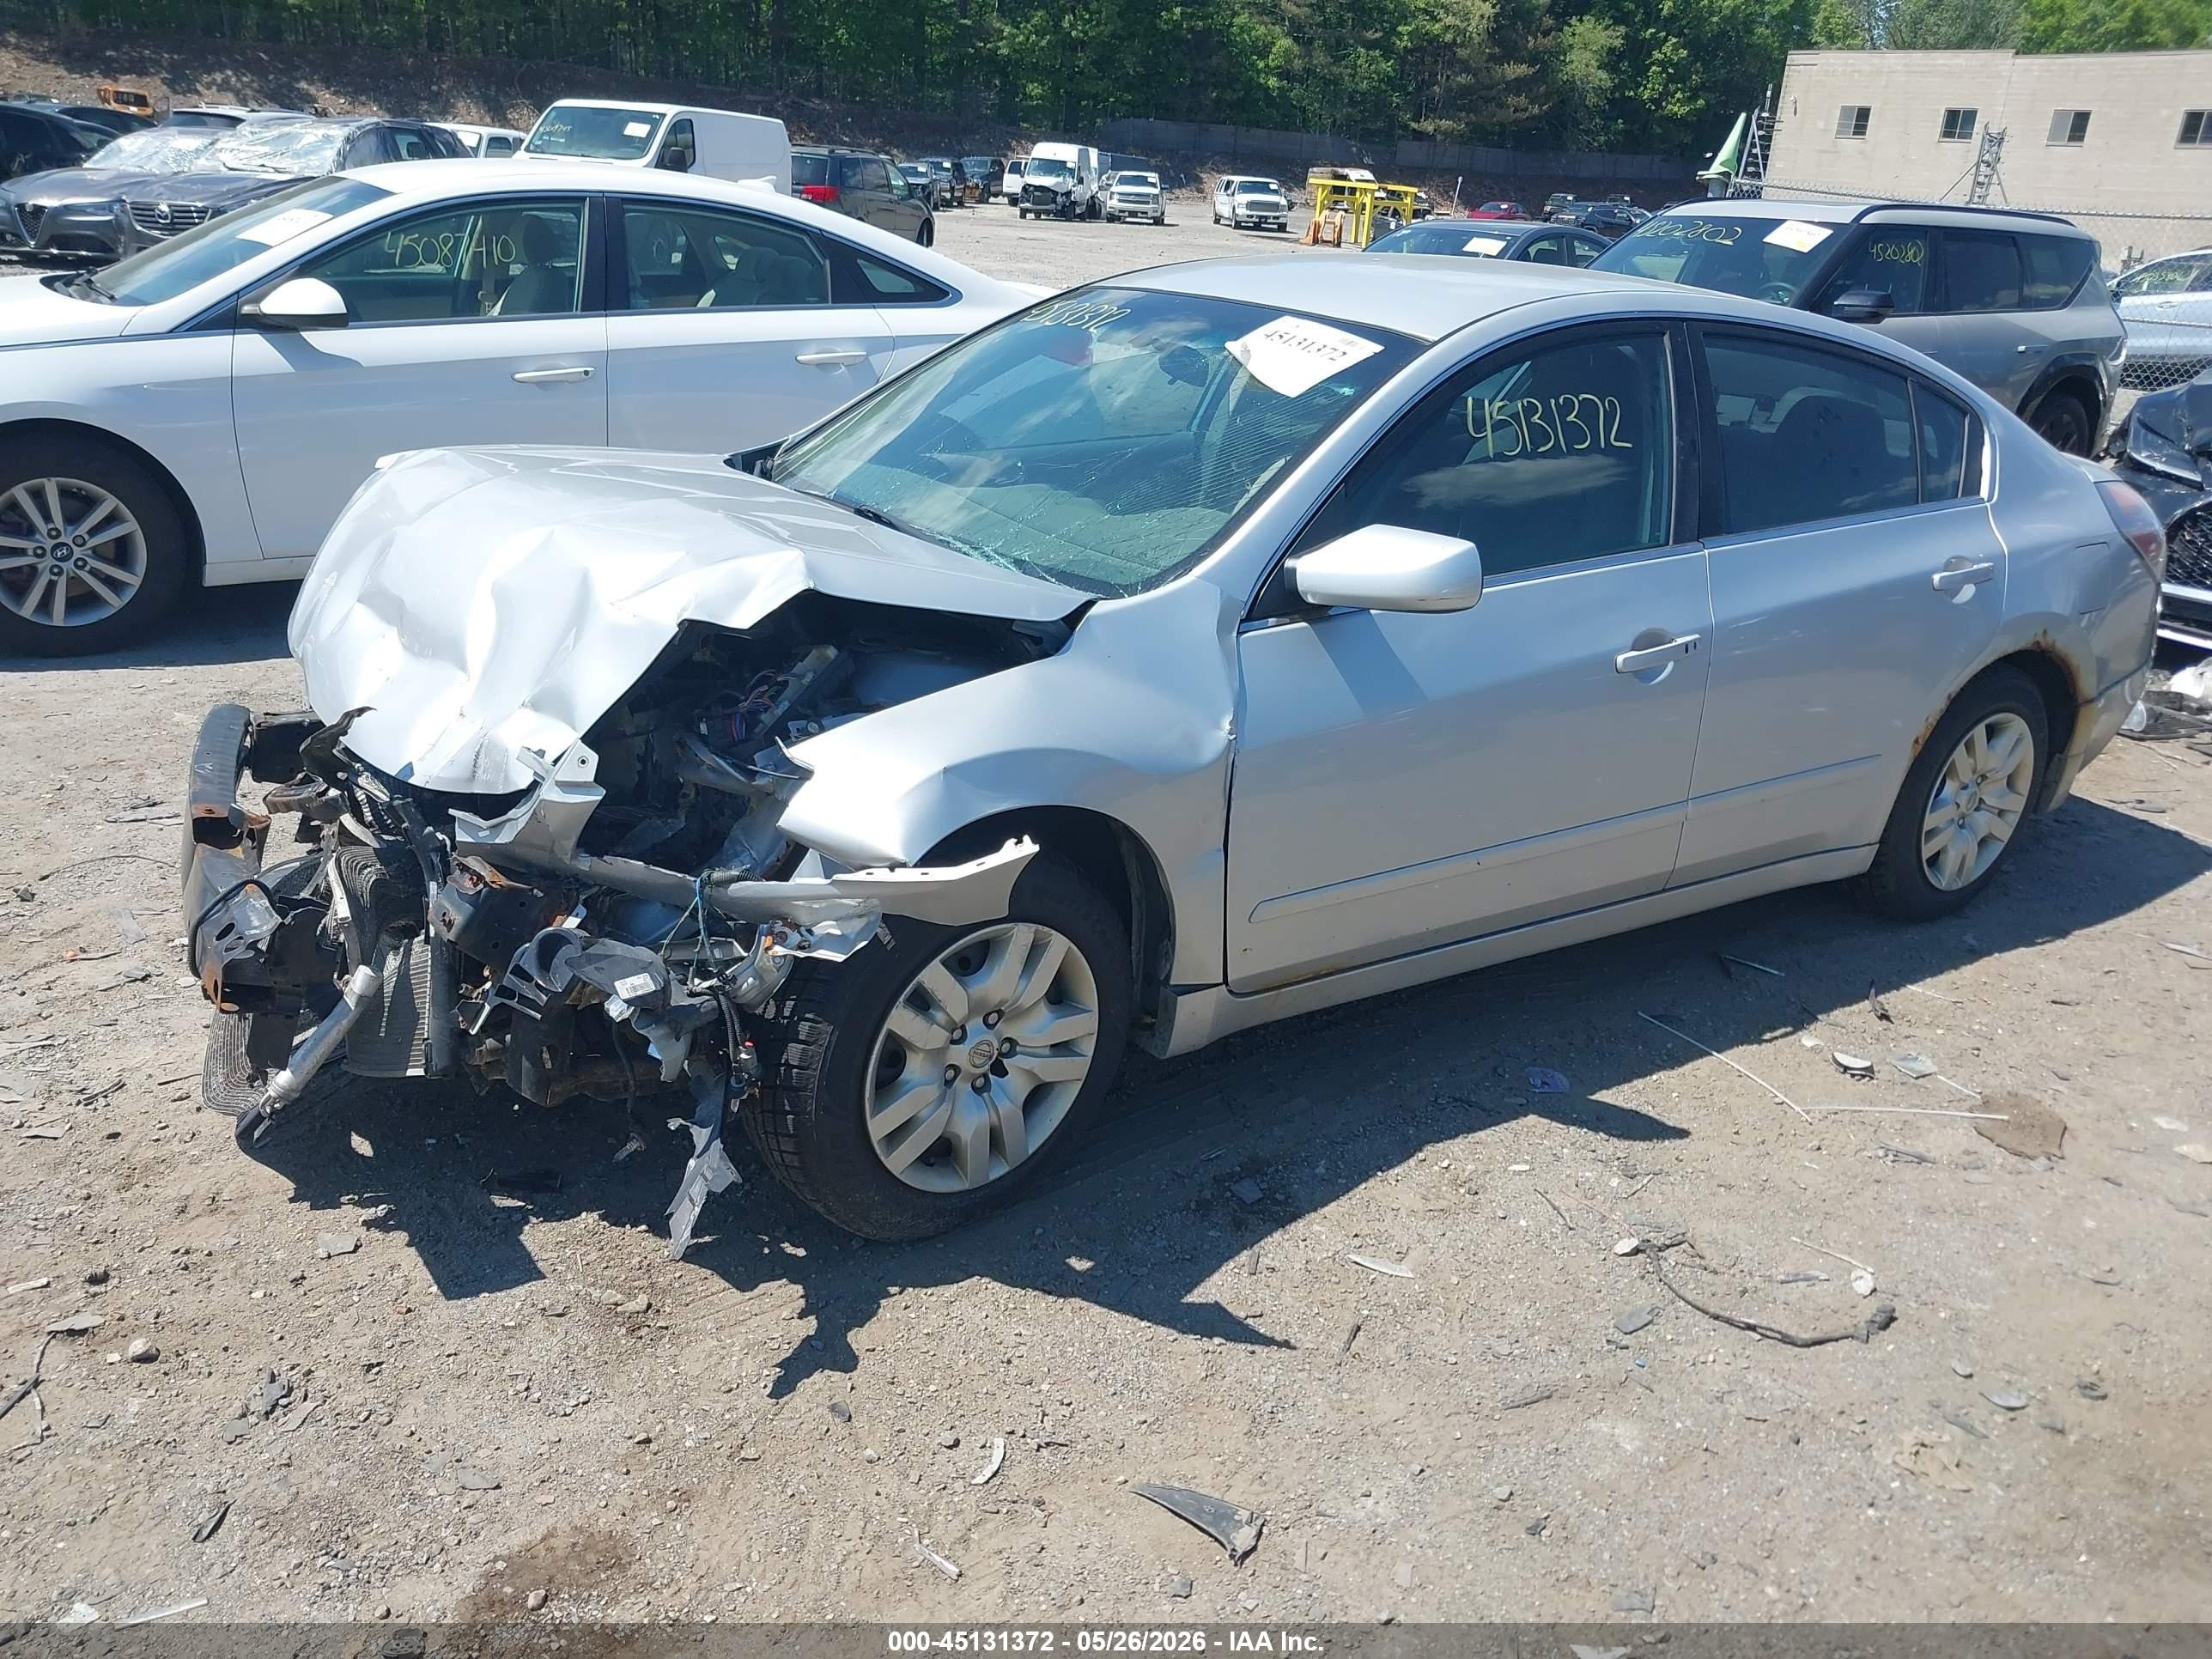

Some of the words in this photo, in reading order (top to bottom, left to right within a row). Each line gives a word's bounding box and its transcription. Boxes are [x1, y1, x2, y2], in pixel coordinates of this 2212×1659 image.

[385, 231, 515, 268] 45087410
[1869, 240, 1924, 267] 45202802
[1263, 330, 1348, 361] 45131372
[1467, 393, 1633, 459] 45131372
